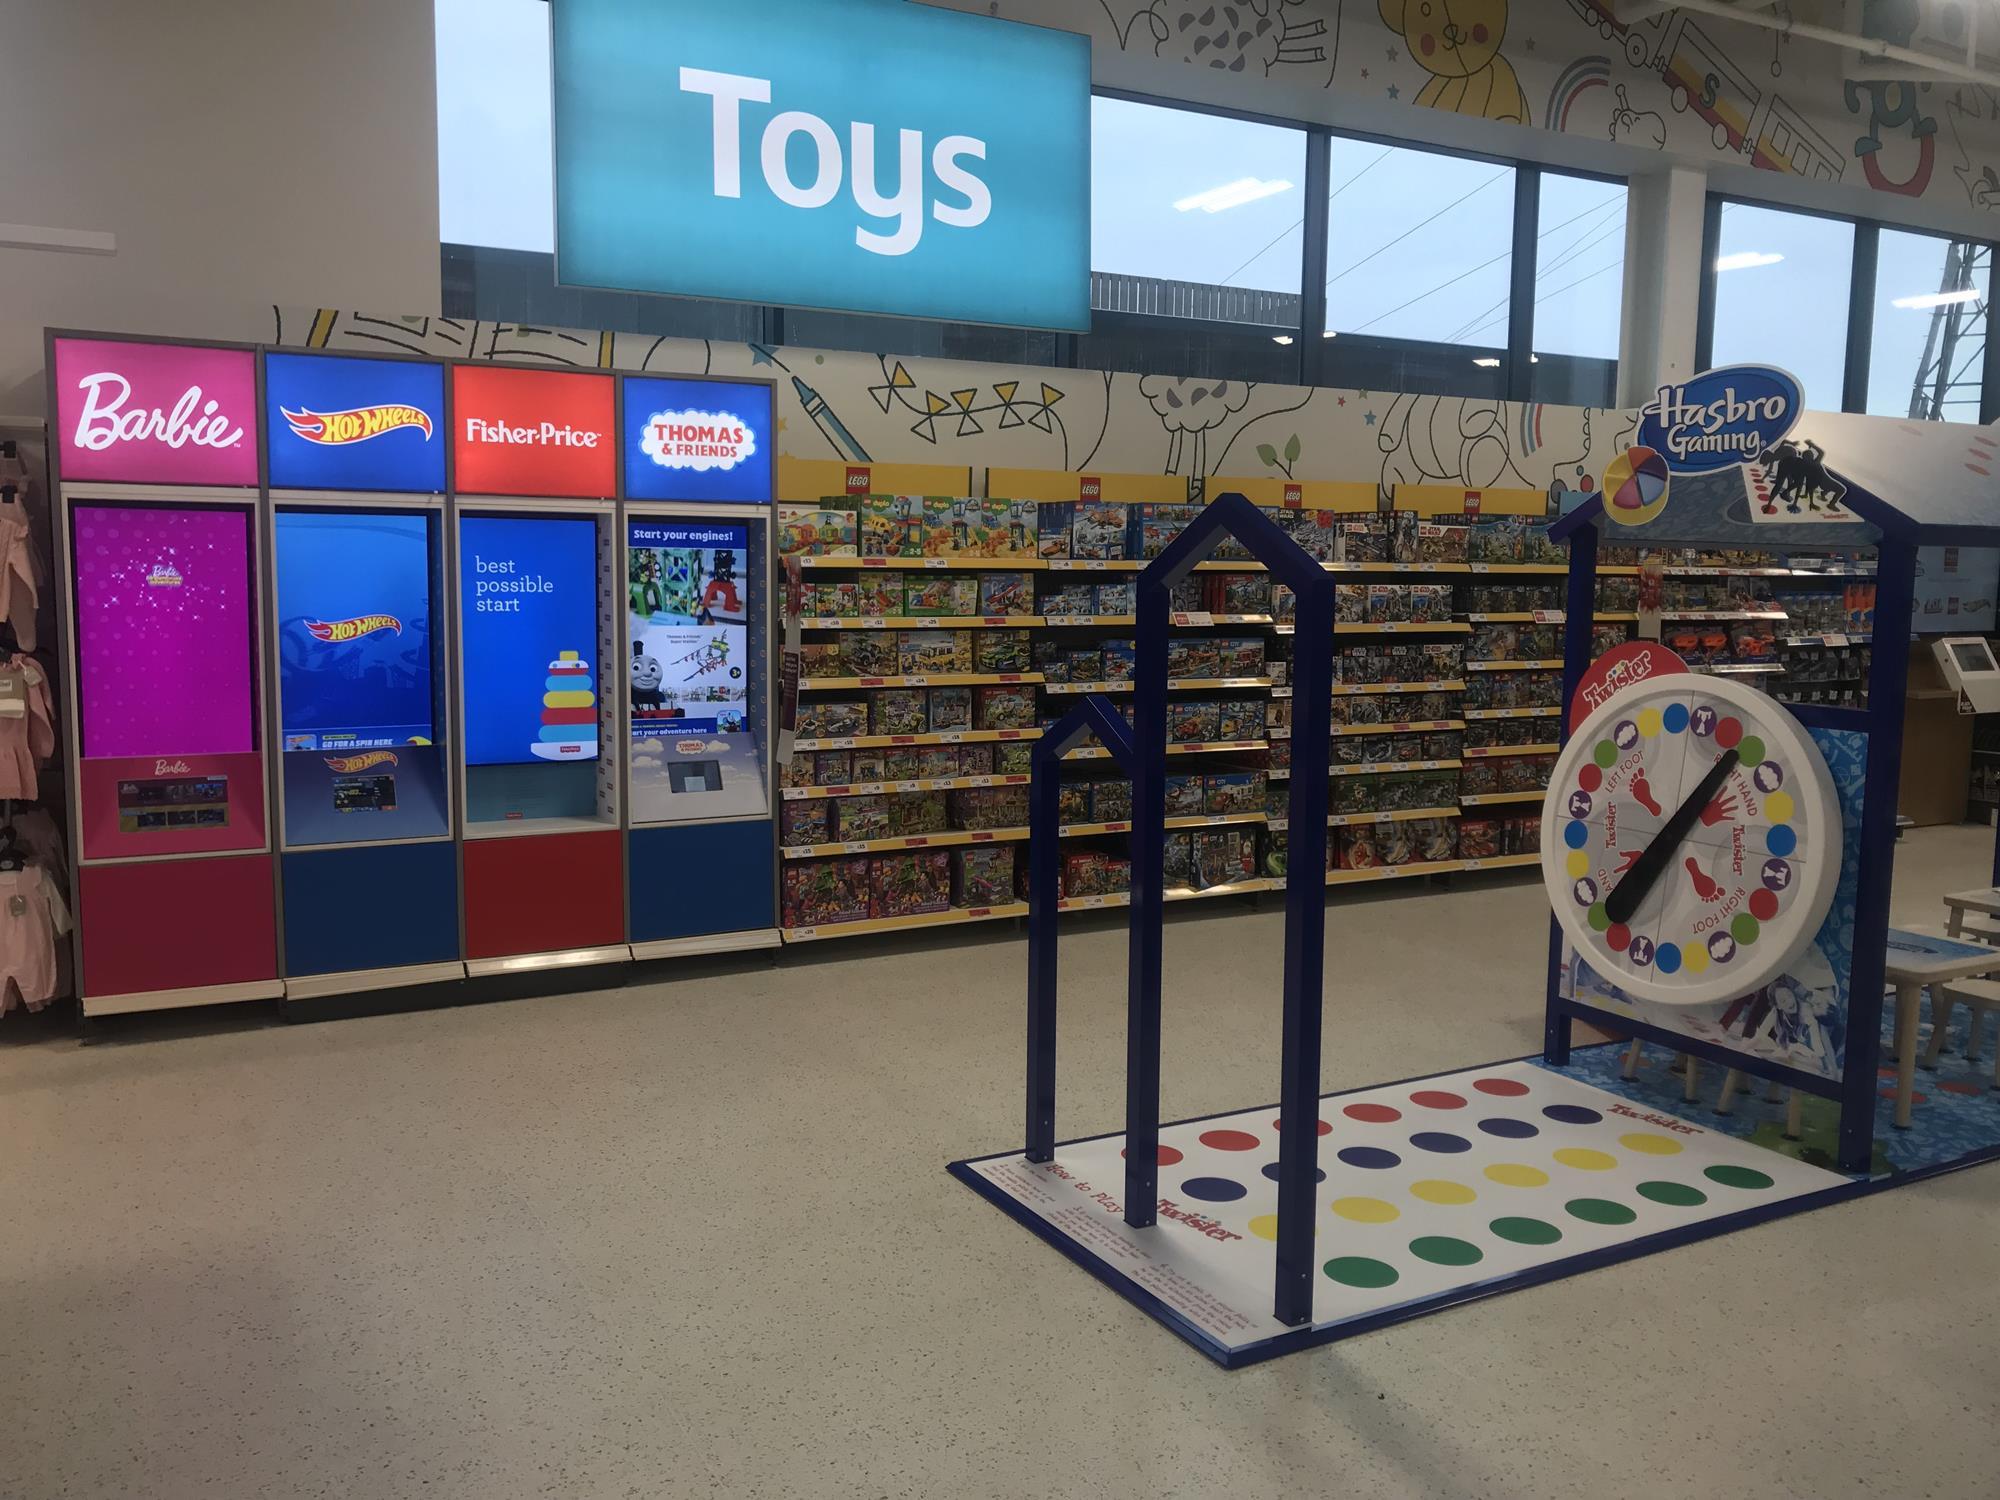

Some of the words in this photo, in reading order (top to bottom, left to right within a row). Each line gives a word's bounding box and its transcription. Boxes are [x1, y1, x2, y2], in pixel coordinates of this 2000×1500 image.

[679, 66, 992, 256] Toys
[74, 372, 243, 451] Barbie
[1642, 387, 1786, 434] Hasbro
[466, 418, 598, 448] Fisher-Price
[654, 423, 743, 445] THOMAS
[1667, 423, 1762, 461] Gaming
[661, 443, 672, 456] &
[676, 443, 738, 458] FRIENDS
[848, 476, 868, 486] LEGO
[1082, 485, 1099, 494] LEGO
[1286, 491, 1301, 500] LEGO
[1465, 498, 1480, 507] LEGO
[634, 529, 661, 539] Start
[662, 531, 688, 542] your
[689, 531, 733, 542] engines!
[475, 555, 515, 574] best
[476, 575, 554, 597] possible
[476, 598, 520, 613] start
[1583, 650, 1651, 711] Twister
[643, 729, 659, 738] your
[154, 759, 191, 776] Barbie
[1605, 772, 1622, 794] LEFT
[1619, 750, 1644, 774] FOOT
[1714, 752, 1742, 783] RHT
[1737, 781, 1758, 817] HAND
[1605, 801, 1617, 849] Twister
[1733, 824, 1745, 876] Twister
[1598, 868, 1614, 892] AND
[1721, 886, 1746, 920] RIGHT
[1692, 910, 1721, 935] FOOT
[1606, 1103, 1704, 1135] Twister
[1045, 1163, 1076, 1180] How
[1075, 1182, 1091, 1192] to
[1090, 1191, 1123, 1213] Play
[1157, 1198, 1243, 1242] Twister
